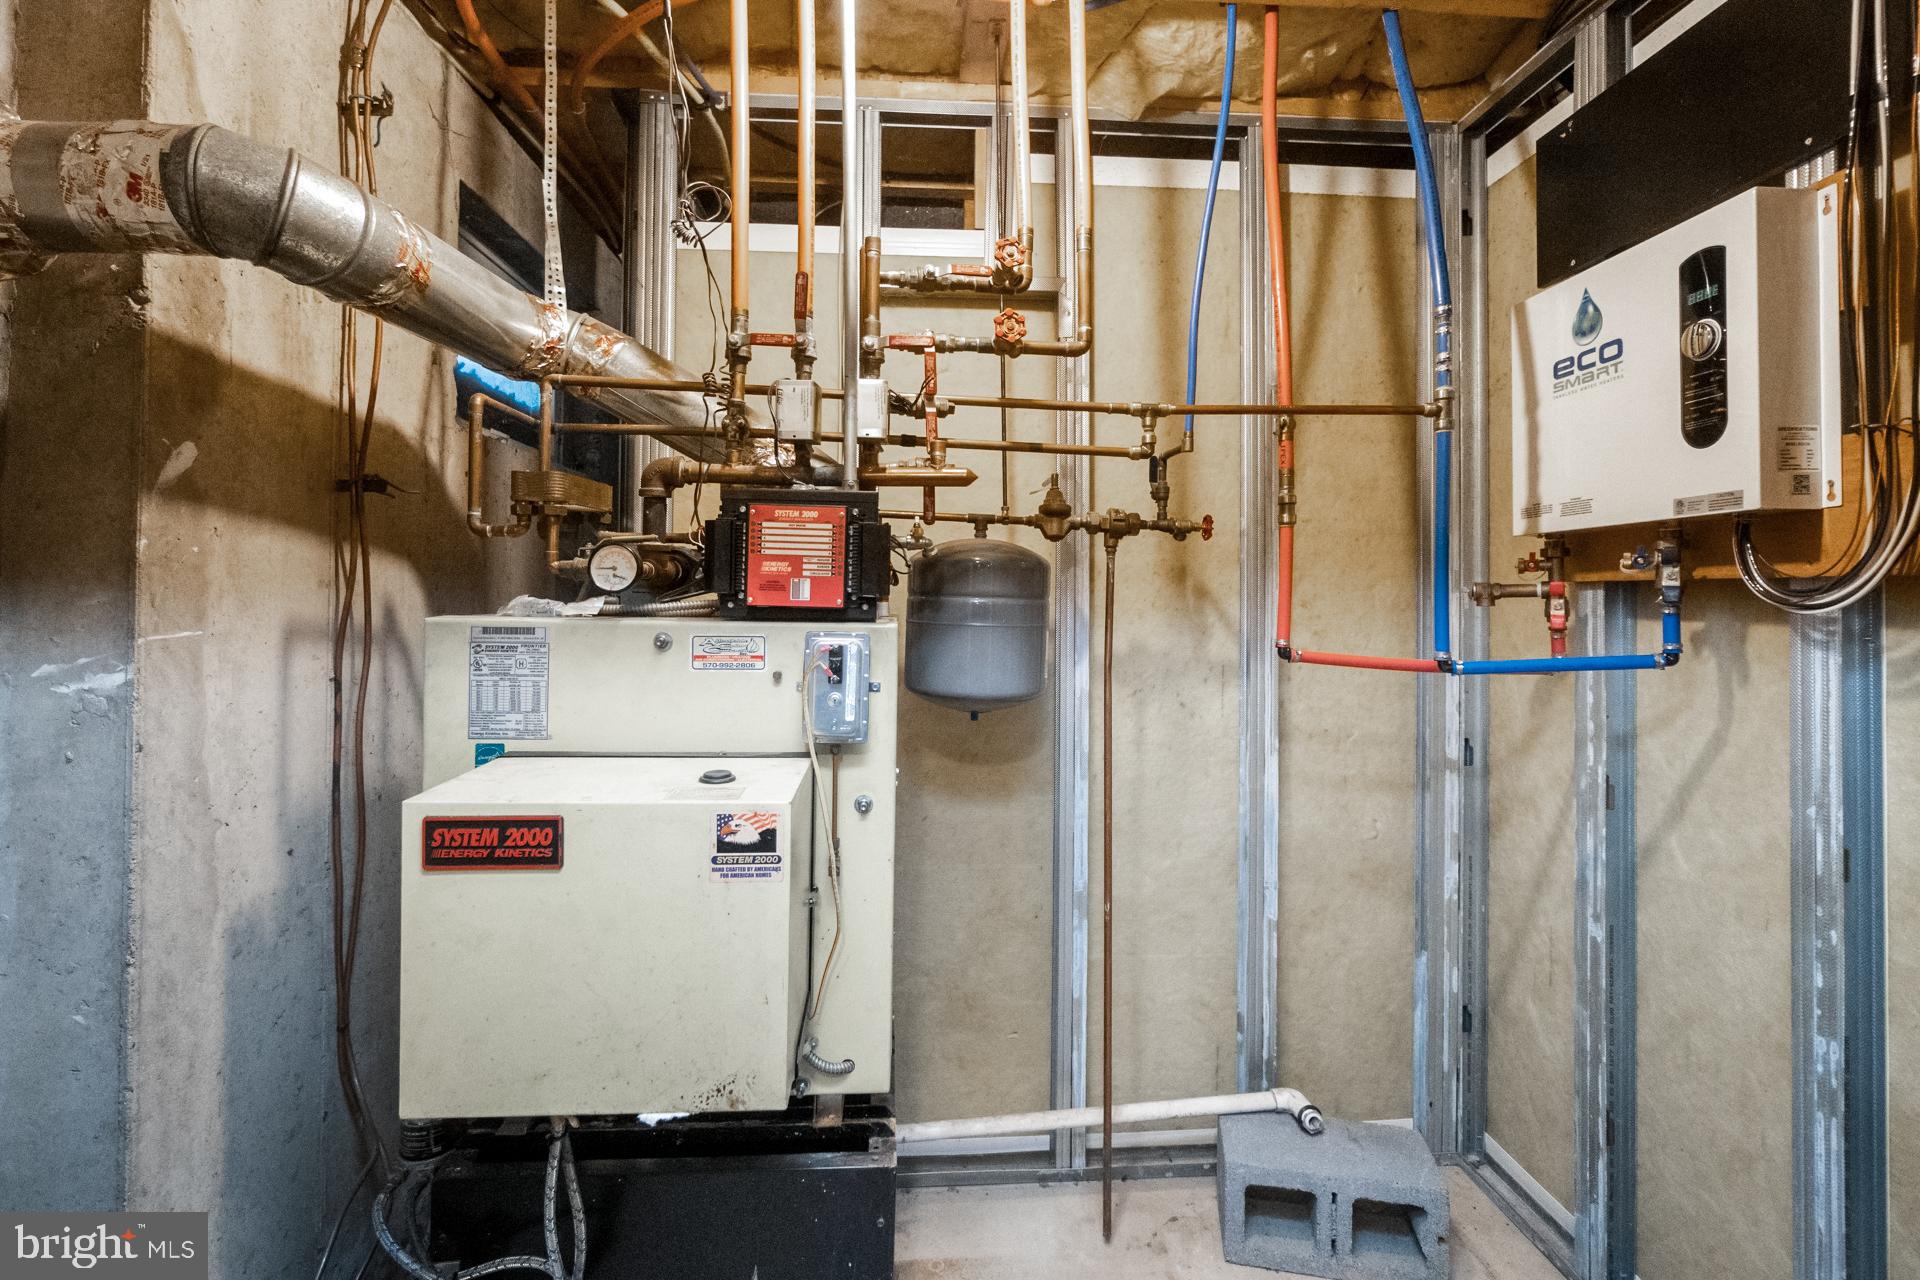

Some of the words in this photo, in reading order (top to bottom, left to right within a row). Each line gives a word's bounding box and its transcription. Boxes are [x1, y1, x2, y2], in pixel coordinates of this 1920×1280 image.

[126, 171, 144, 203] 3M
[1553, 338, 1624, 380] eco
[774, 509, 800, 518] SYSTEM
[801, 510, 819, 519] 2000
[431, 827, 499, 847] SYSTEM
[503, 827, 553, 847] 2000
[440, 848, 491, 858] ENERGY
[494, 848, 553, 858] KINETICS
[716, 855, 753, 864] SYSTEM
[754, 855, 779, 863] 2000
